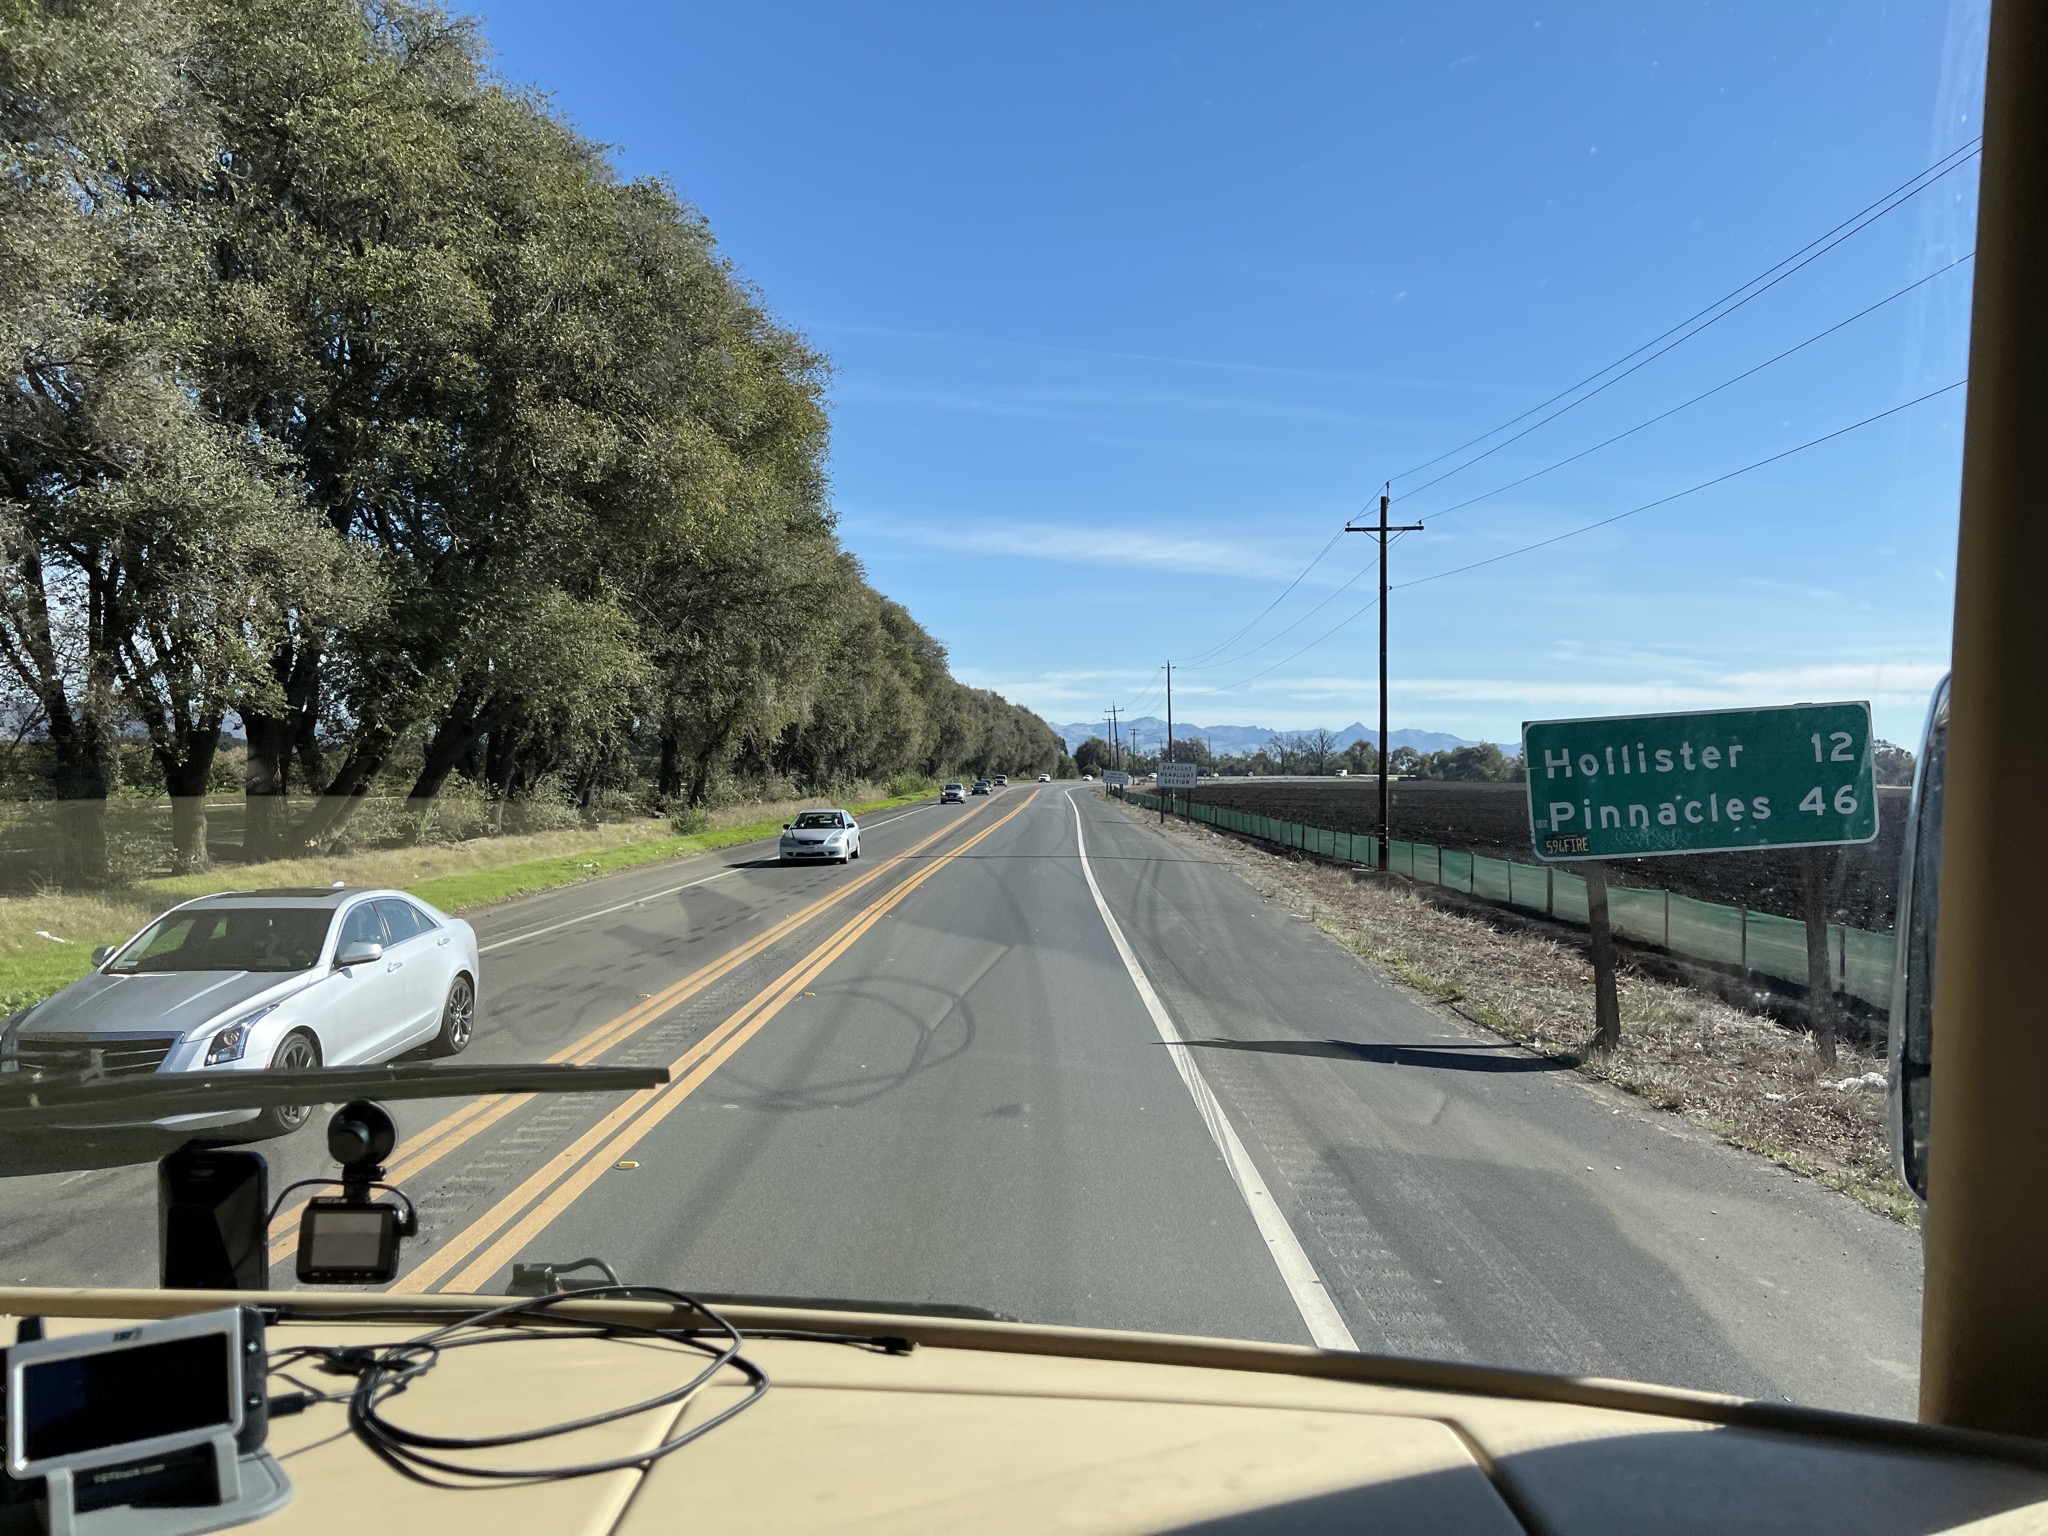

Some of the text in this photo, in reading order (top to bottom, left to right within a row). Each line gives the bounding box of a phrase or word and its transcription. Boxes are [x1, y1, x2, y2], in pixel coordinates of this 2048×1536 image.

[1544, 731, 1855, 779] Hollister 12
[1549, 784, 1858, 831] Pinnacles 46
